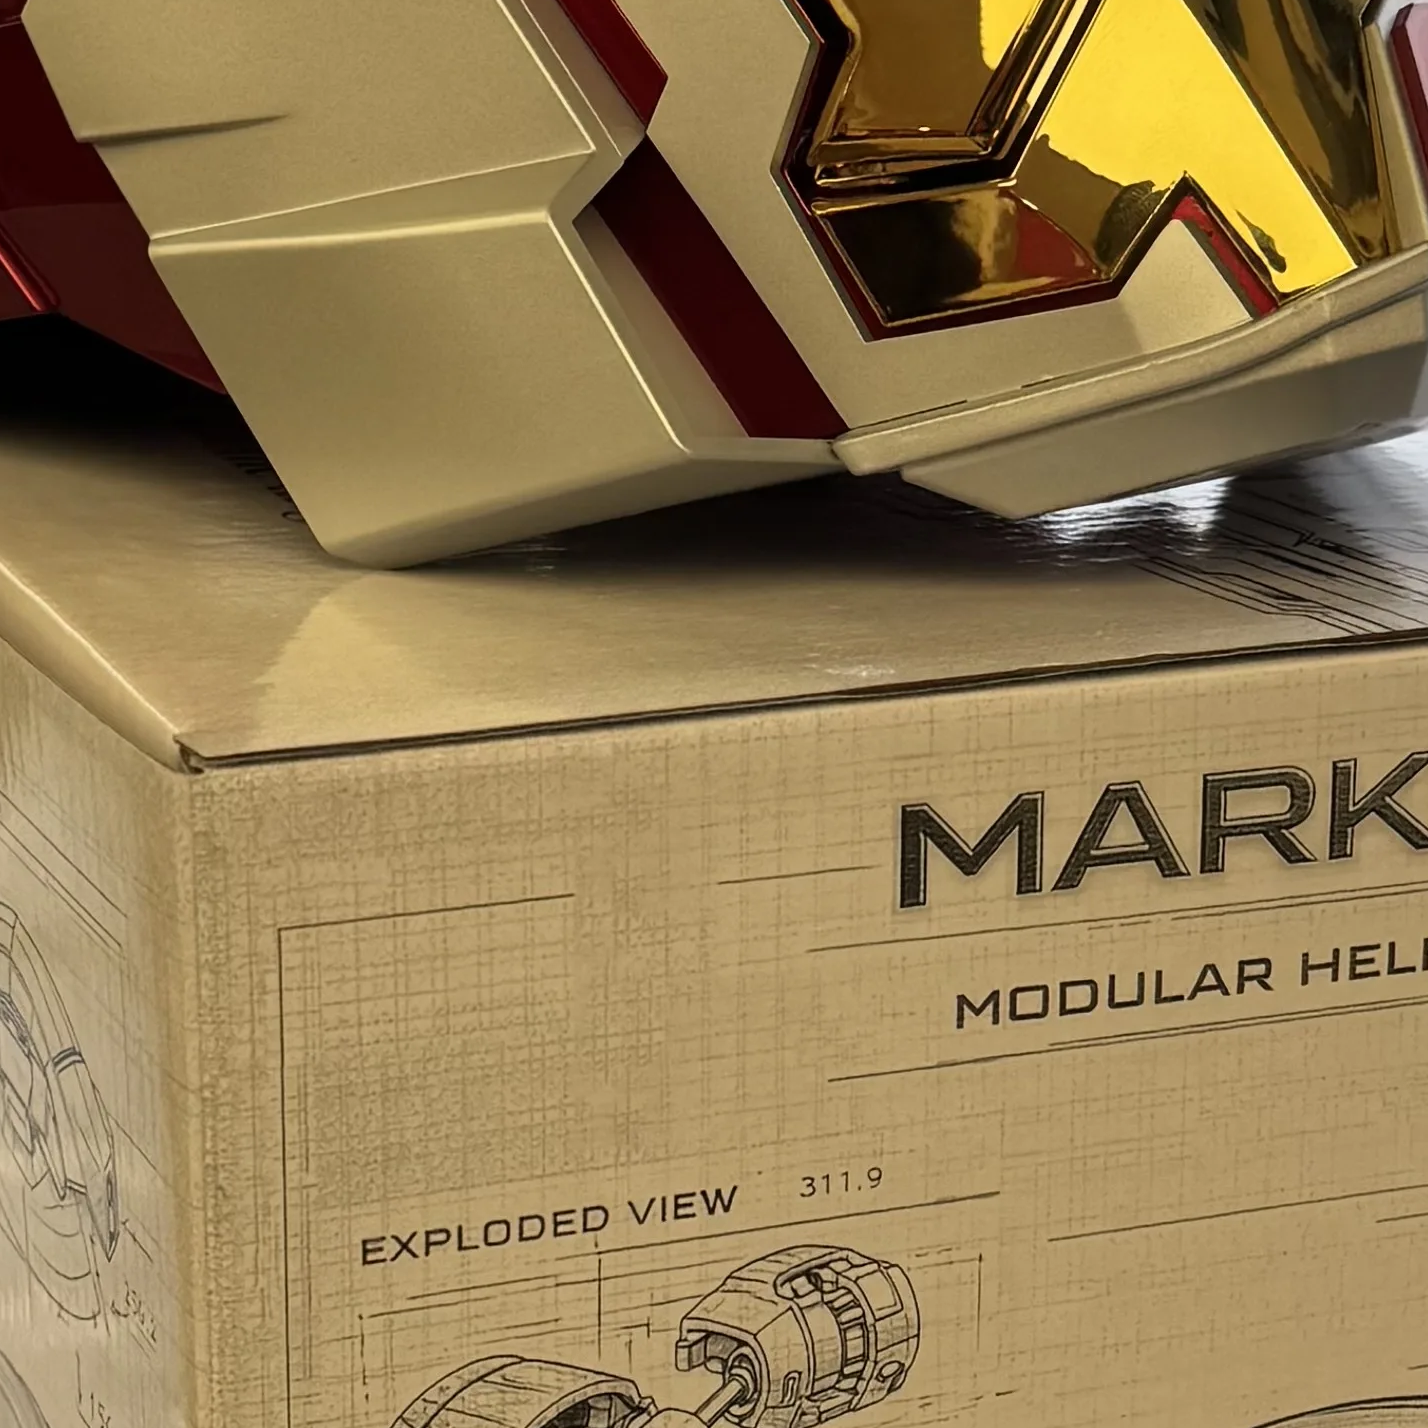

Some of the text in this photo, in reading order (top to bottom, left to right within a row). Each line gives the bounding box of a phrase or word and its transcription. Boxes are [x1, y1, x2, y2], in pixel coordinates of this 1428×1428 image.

[955, 956, 1275, 1030] MODULAR
[360, 1166, 884, 1265] EXPLODED VIEW 311.9
